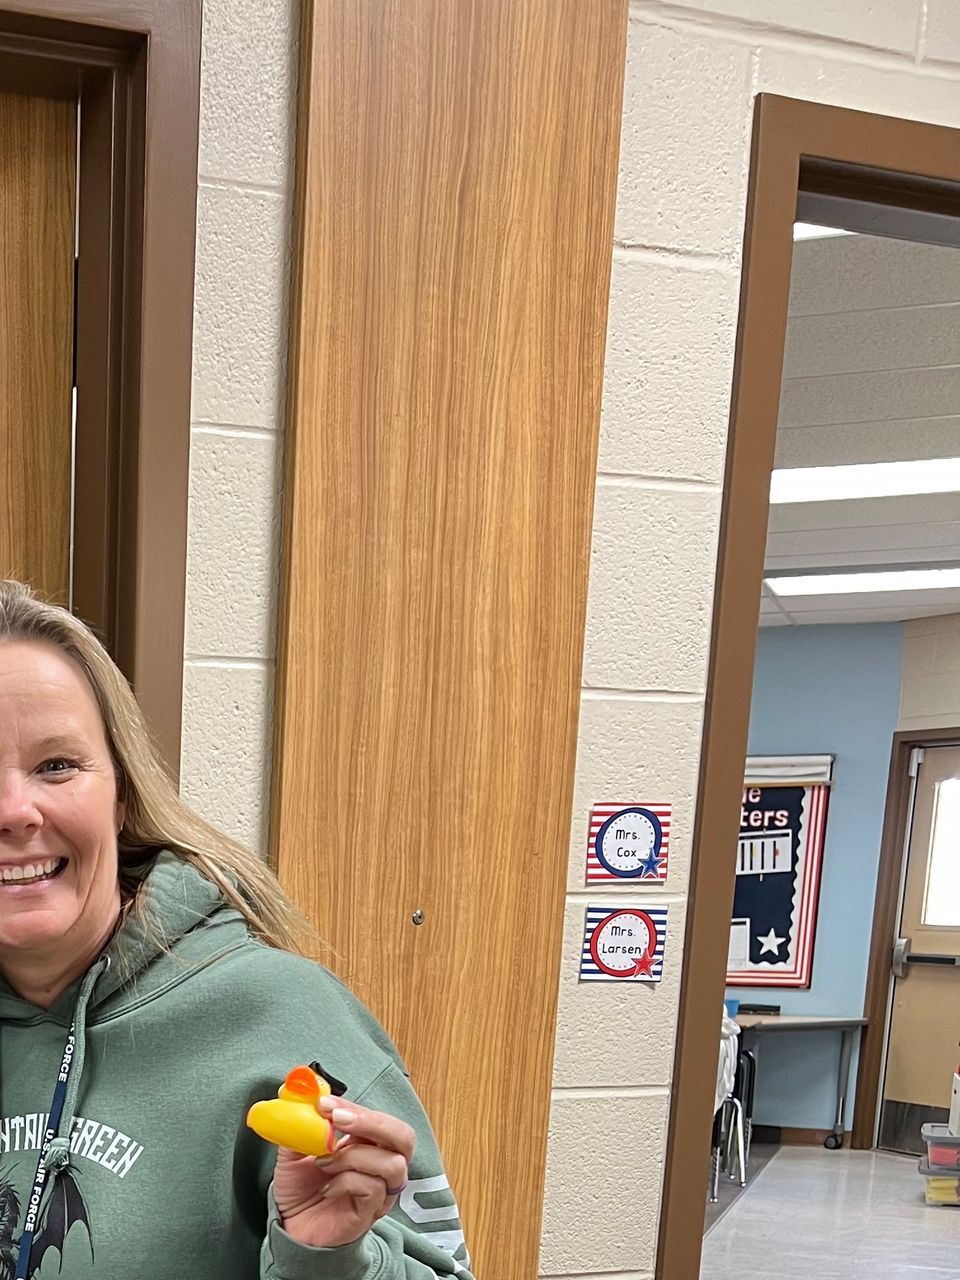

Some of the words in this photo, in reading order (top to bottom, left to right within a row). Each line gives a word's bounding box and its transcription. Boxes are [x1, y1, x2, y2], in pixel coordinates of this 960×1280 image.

[616, 829, 640, 840] Mrs.
[617, 846, 637, 857] Cox
[611, 926, 636, 937] Mrs.
[602, 943, 642, 954] Larsen
[58, 1035, 75, 1082] FORCE
[69, 1115, 145, 1179] GREEN
[25, 1186, 42, 1232] FORCE
